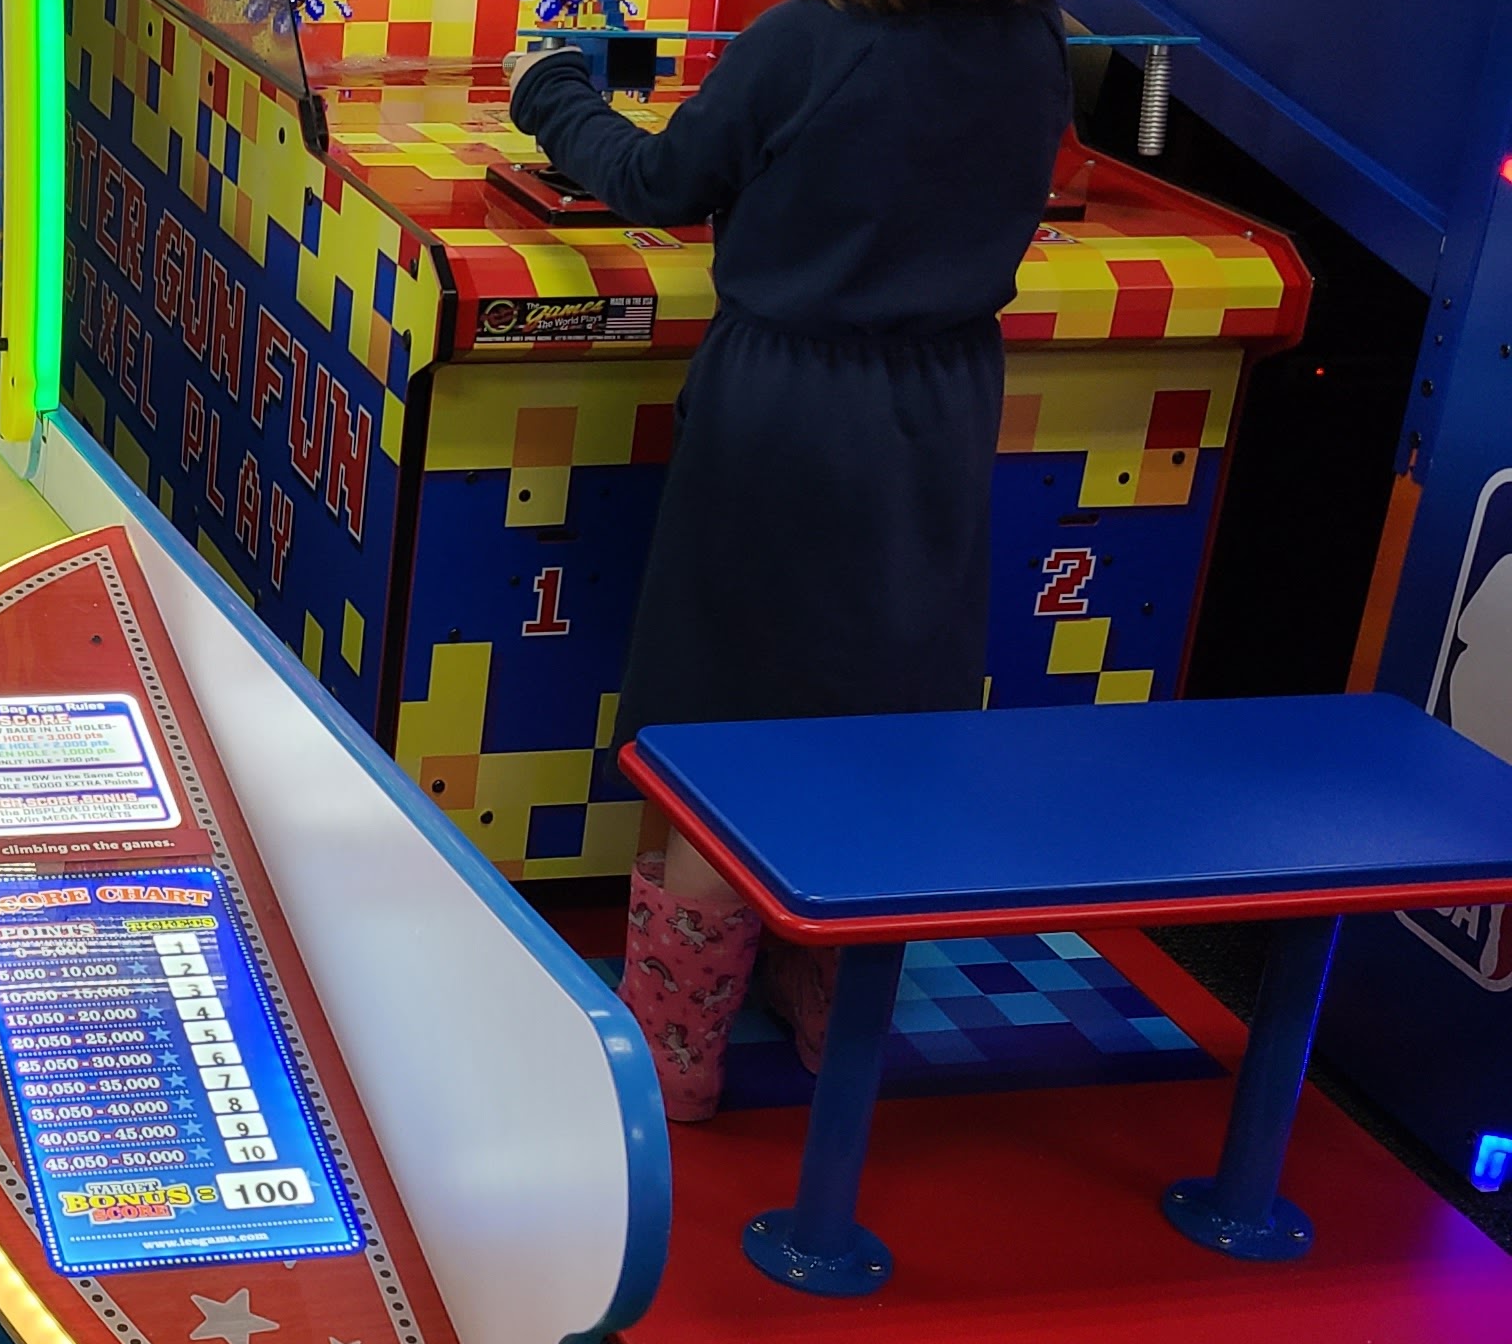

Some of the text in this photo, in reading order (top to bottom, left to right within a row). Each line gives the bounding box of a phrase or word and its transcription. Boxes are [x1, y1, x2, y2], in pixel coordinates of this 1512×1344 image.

[536, 319, 553, 330] The
[554, 315, 580, 327] World
[152, 207, 247, 403] GUN
[251, 304, 373, 545] FUN
[180, 378, 294, 593] PLAY
[1032, 546, 1098, 617] 2
[520, 565, 571, 638] 1
[31, 703, 65, 714] Toss
[66, 701, 107, 712] Rules
[3, 733, 35, 743] HOLE
[84, 731, 104, 741] pts
[5, 726, 38, 735] BAGS
[40, 725, 53, 734] IN
[55, 724, 76, 733] LIT
[1, 843, 68, 856] climbing
[70, 842, 91, 852] on
[93, 840, 120, 851] the
[121, 838, 176, 852] games.
[95, 886, 213, 907] CHART
[123, 916, 219, 934] TICKETS
[174, 940, 186, 954] 1
[60, 964, 118, 978] 10,000
[180, 962, 192, 975] 2
[187, 983, 202, 997] 3
[6, 1007, 138, 1027] 15,050 20,000
[196, 1007, 210, 1020] 4
[10, 1030, 145, 1050] 20,050 25,000
[203, 1028, 217, 1042] 5
[17, 1052, 153, 1073] 25,050 30,000
[212, 1051, 226, 1065] 6
[23, 1076, 161, 1097] 30,050 35,000
[217, 1073, 231, 1088] 7
[30, 1100, 169, 1121] 35,050 40,000
[227, 1096, 243, 1112] 8
[37, 1124, 177, 1147] 40,050 45,000
[236, 1122, 250, 1137] 9
[45, 1149, 185, 1172] 45,050 50,000
[239, 1145, 266, 1161] 10
[87, 1179, 160, 1196] TARGET
[61, 1186, 190, 1214] BONUS
[234, 1180, 299, 1205] 100
[92, 1203, 173, 1223] SCORE
[141, 1231, 270, 1251] www.icegame.com
